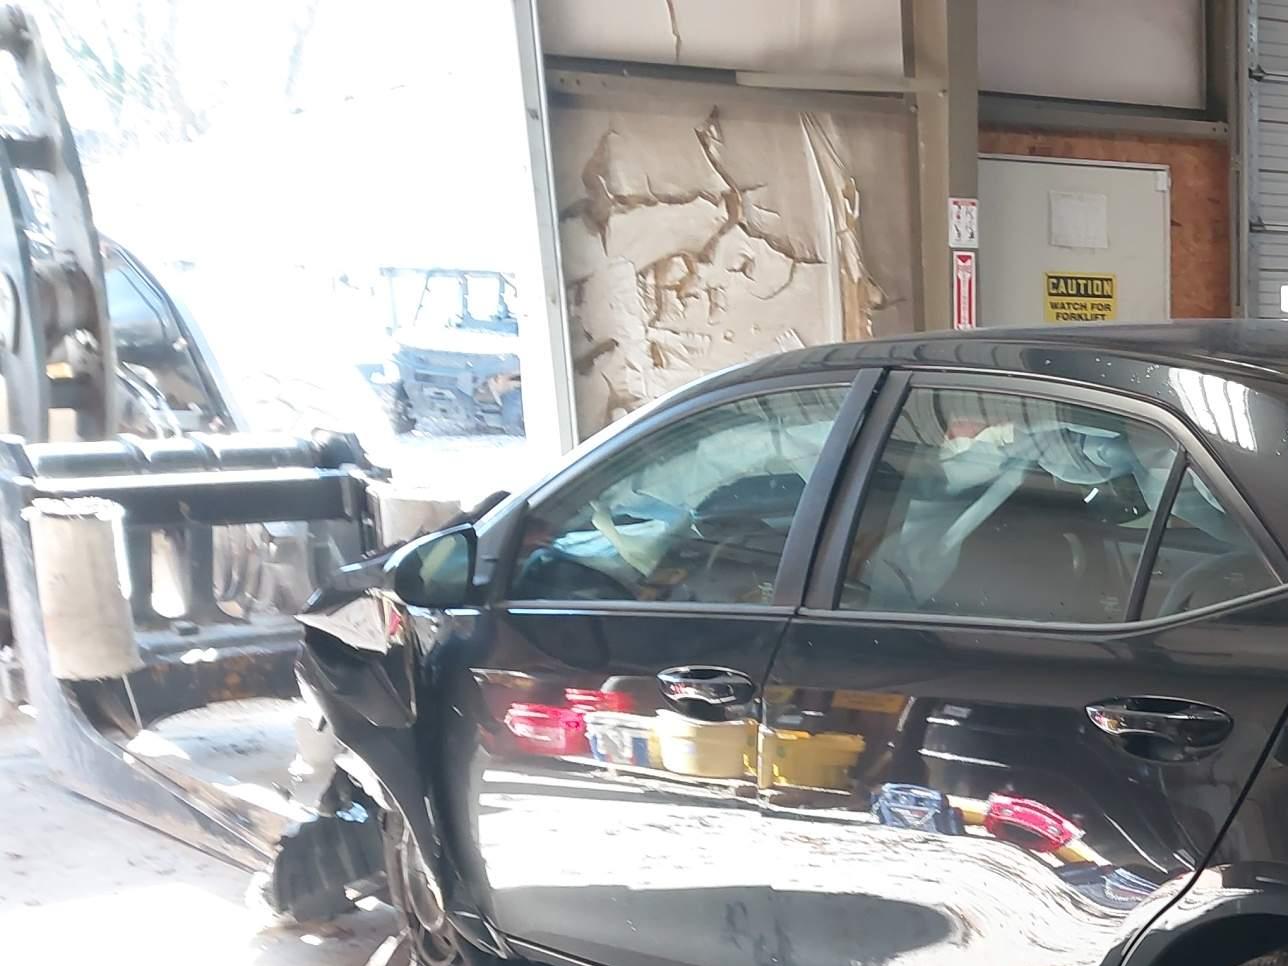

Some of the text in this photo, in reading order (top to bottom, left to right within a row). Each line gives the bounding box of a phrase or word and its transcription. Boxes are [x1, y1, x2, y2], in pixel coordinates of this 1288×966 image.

[1048, 277, 1113, 296] CAUTION
[1049, 301, 1112, 312] WATCH FOR
[1055, 312, 1107, 321] FORKLIFT
